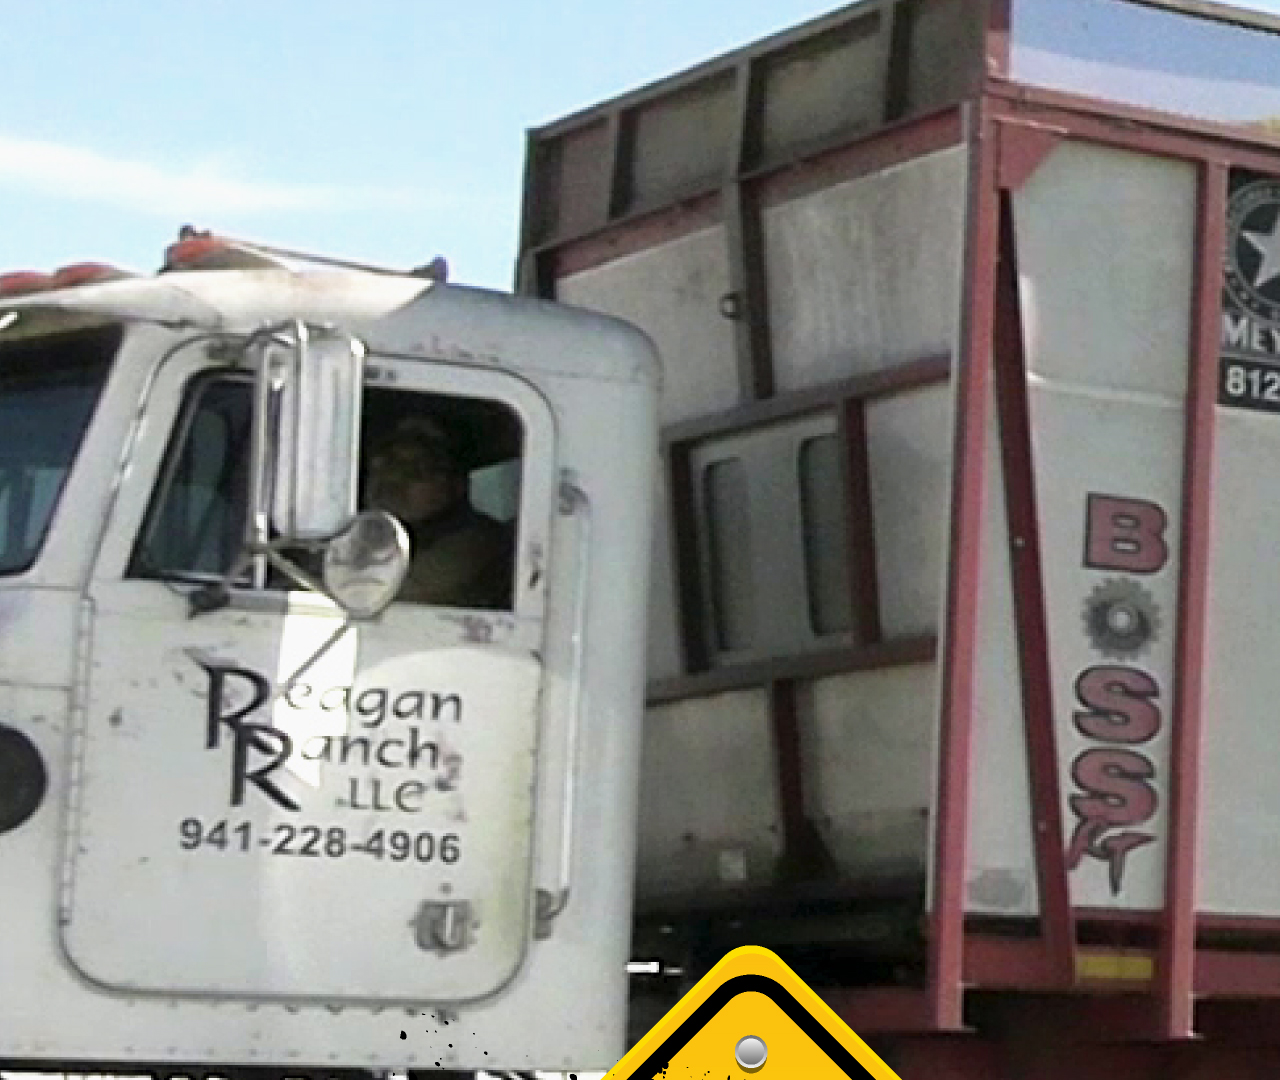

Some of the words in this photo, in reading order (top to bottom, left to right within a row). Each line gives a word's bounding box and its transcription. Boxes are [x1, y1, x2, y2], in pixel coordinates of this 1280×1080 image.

[186, 650, 463, 755] Reagan
[229, 725, 438, 812] Ranch
[179, 817, 462, 865] 941-228-4906
